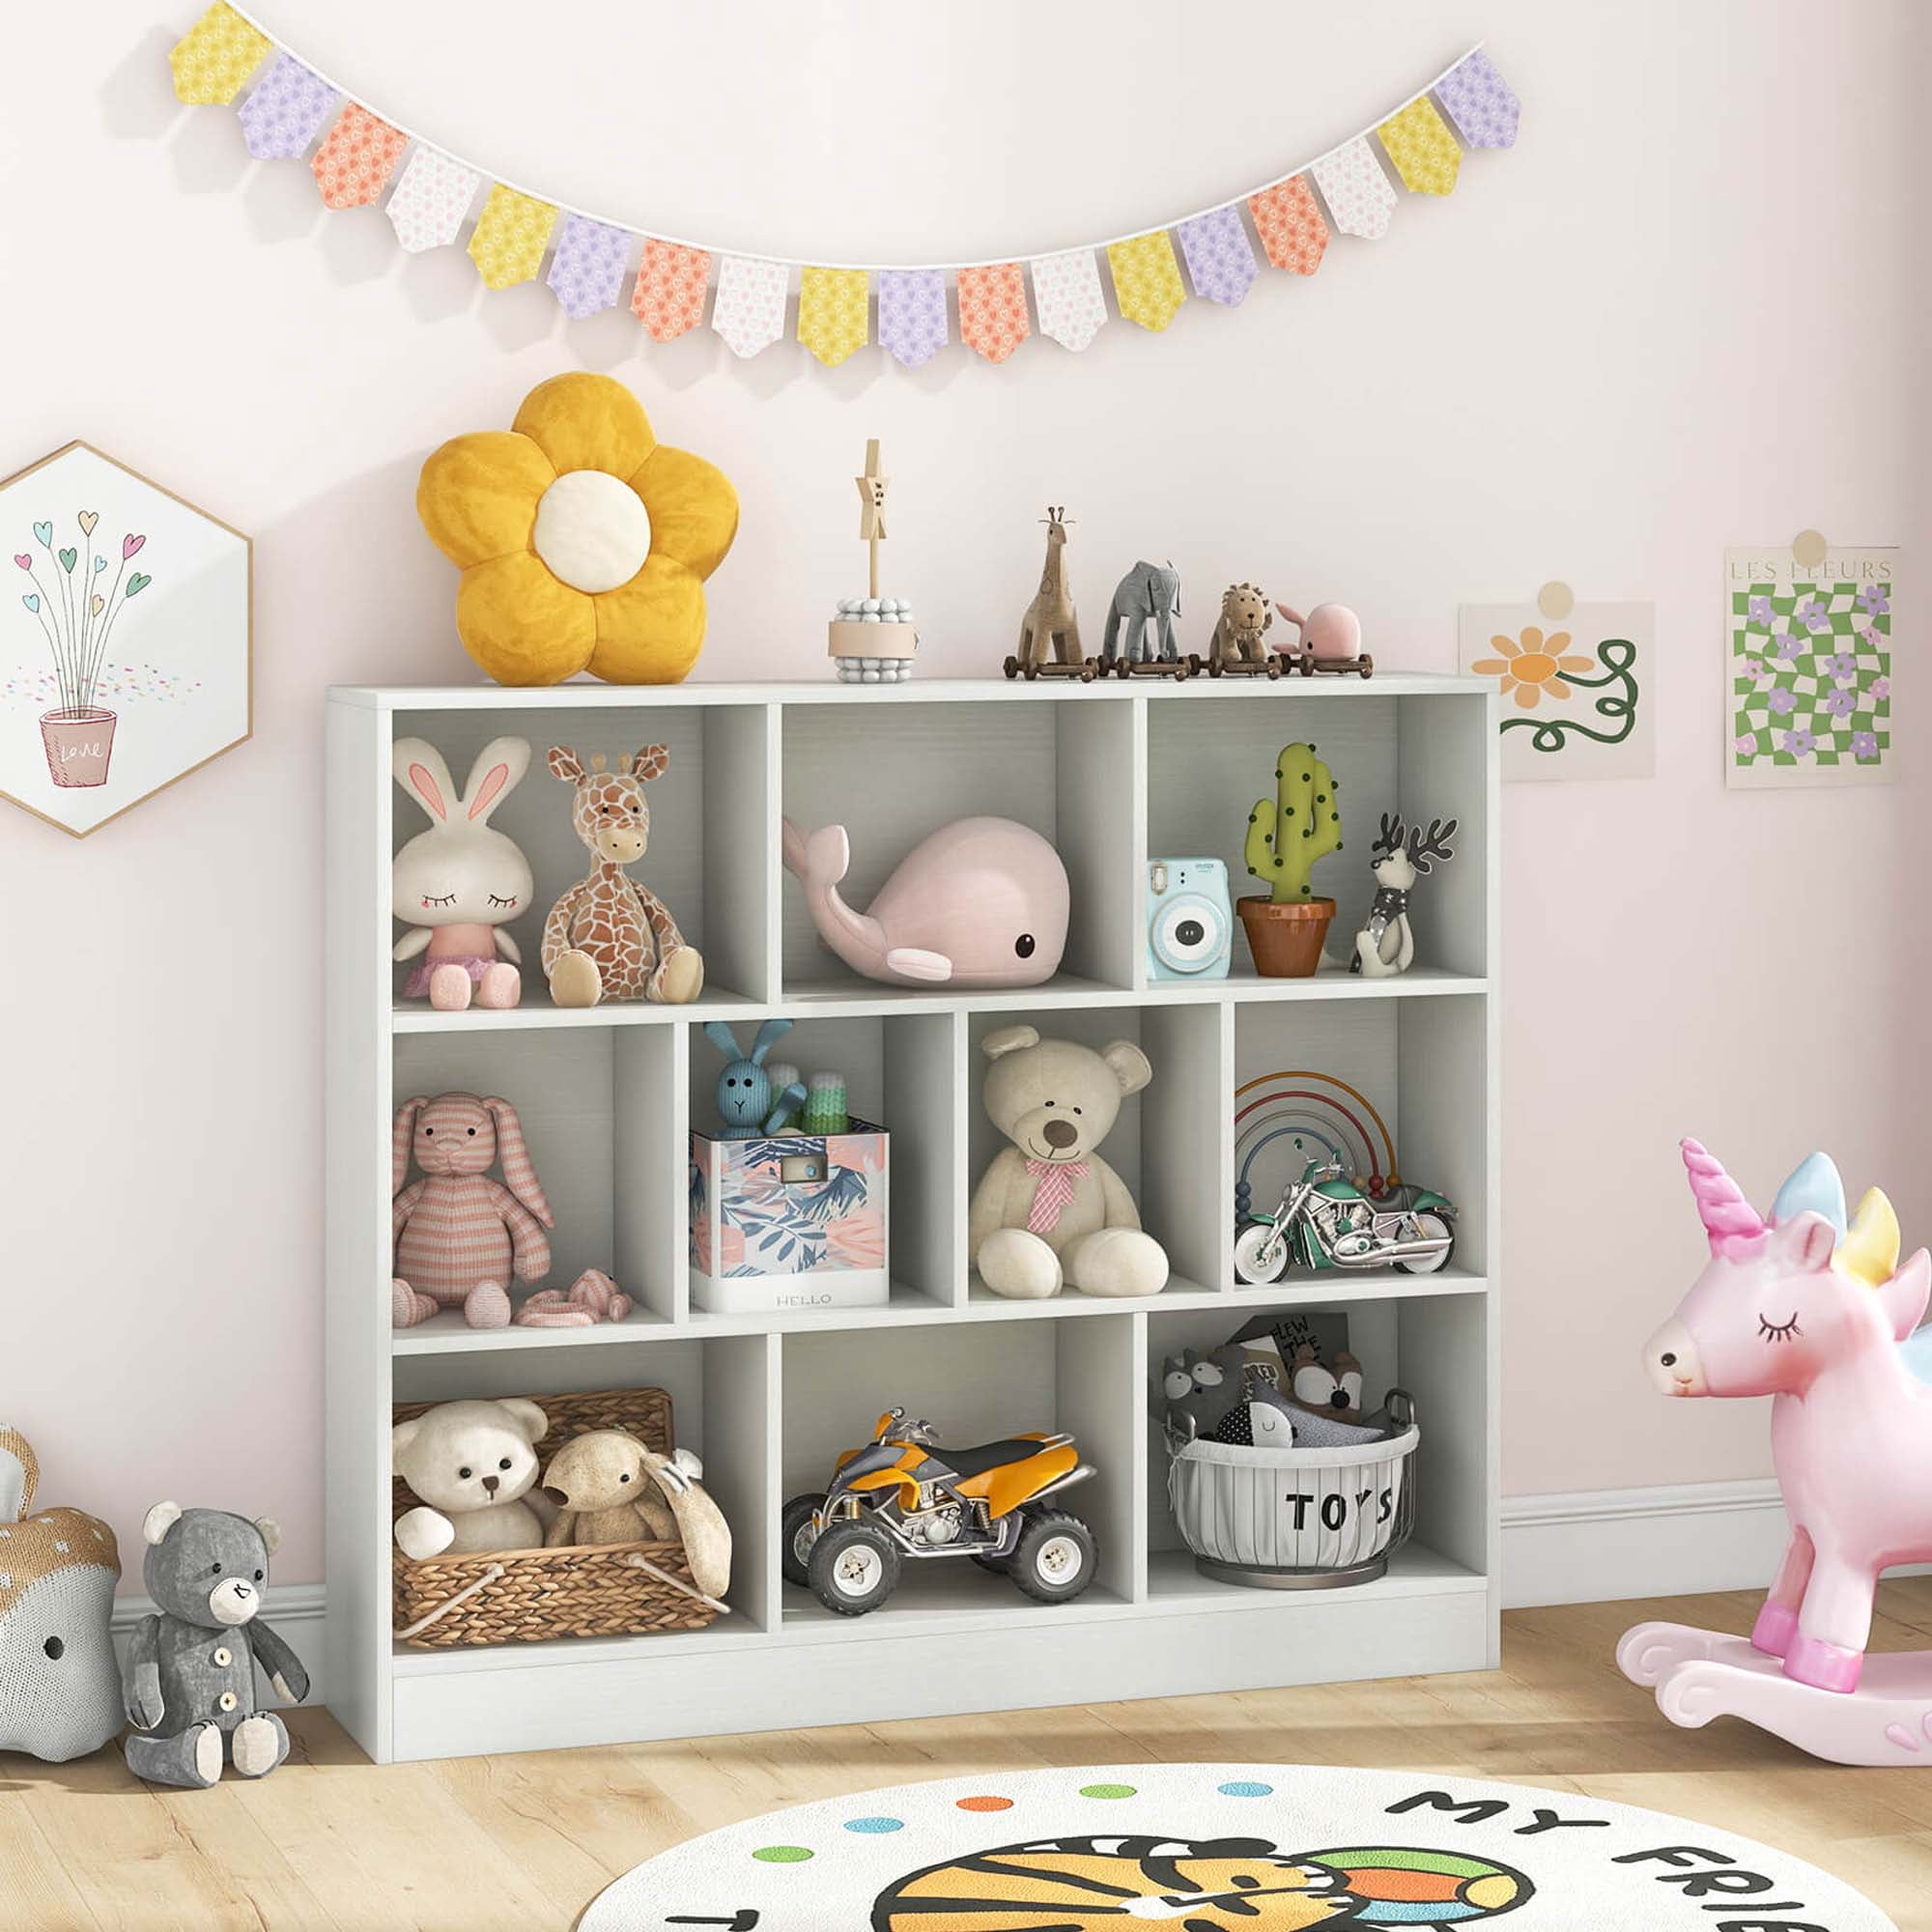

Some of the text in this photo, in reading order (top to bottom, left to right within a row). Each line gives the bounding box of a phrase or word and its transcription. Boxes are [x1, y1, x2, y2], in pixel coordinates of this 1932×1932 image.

[1731, 561, 1777, 580] LES
[776, 1293, 832, 1307] HELLO
[1286, 1488, 1392, 1531] TOYS
[1385, 1790, 1611, 1834] MY
